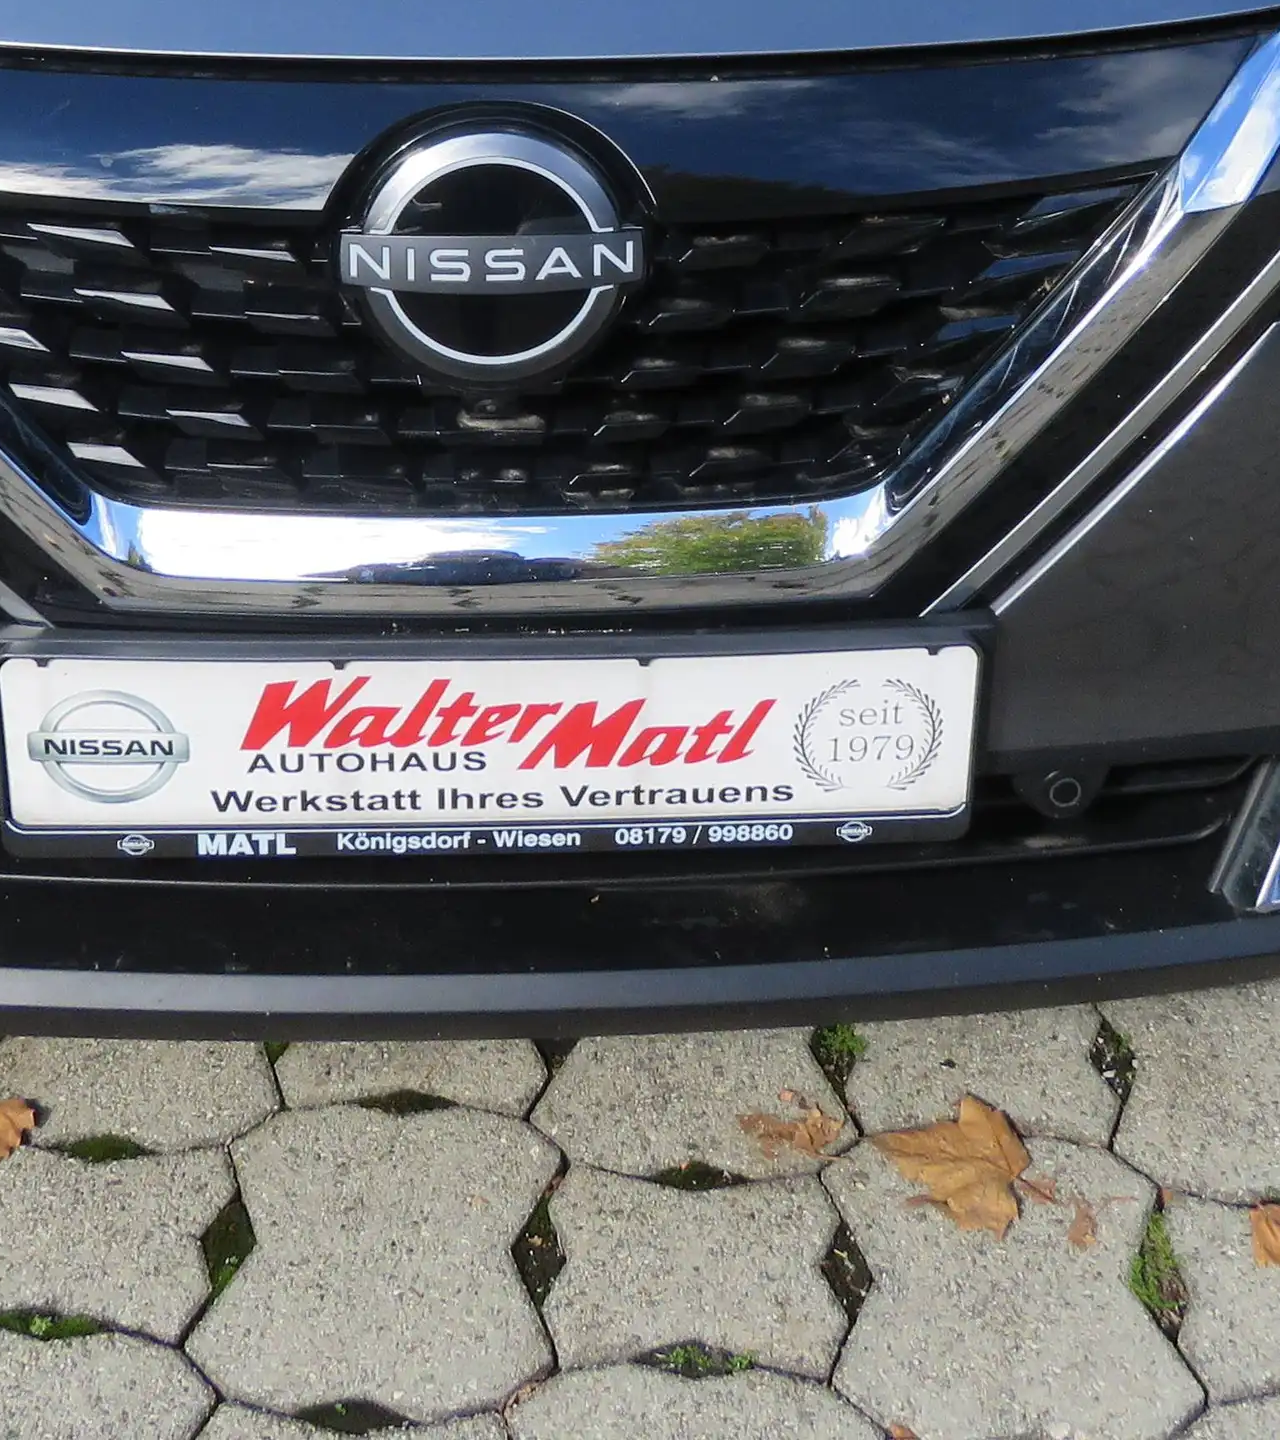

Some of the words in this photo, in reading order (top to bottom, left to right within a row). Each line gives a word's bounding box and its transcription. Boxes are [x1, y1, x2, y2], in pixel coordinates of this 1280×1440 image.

[348, 239, 635, 283] NISSAN
[240, 675, 564, 750] Walter
[517, 697, 778, 770] Matl
[839, 699, 904, 727] seit
[43, 738, 174, 756] NISSAN
[827, 733, 915, 763] 1979
[247, 751, 487, 774] AUTOHAUS
[211, 788, 422, 813] Werkstatt
[438, 787, 544, 810] Ihres
[559, 783, 793, 808] Vertrauens
[197, 833, 297, 855] MATL
[337, 831, 471, 852] Königsdorf
[492, 829, 581, 848] Wiesen
[614, 827, 688, 846] 08179
[707, 823, 794, 843] 998860
